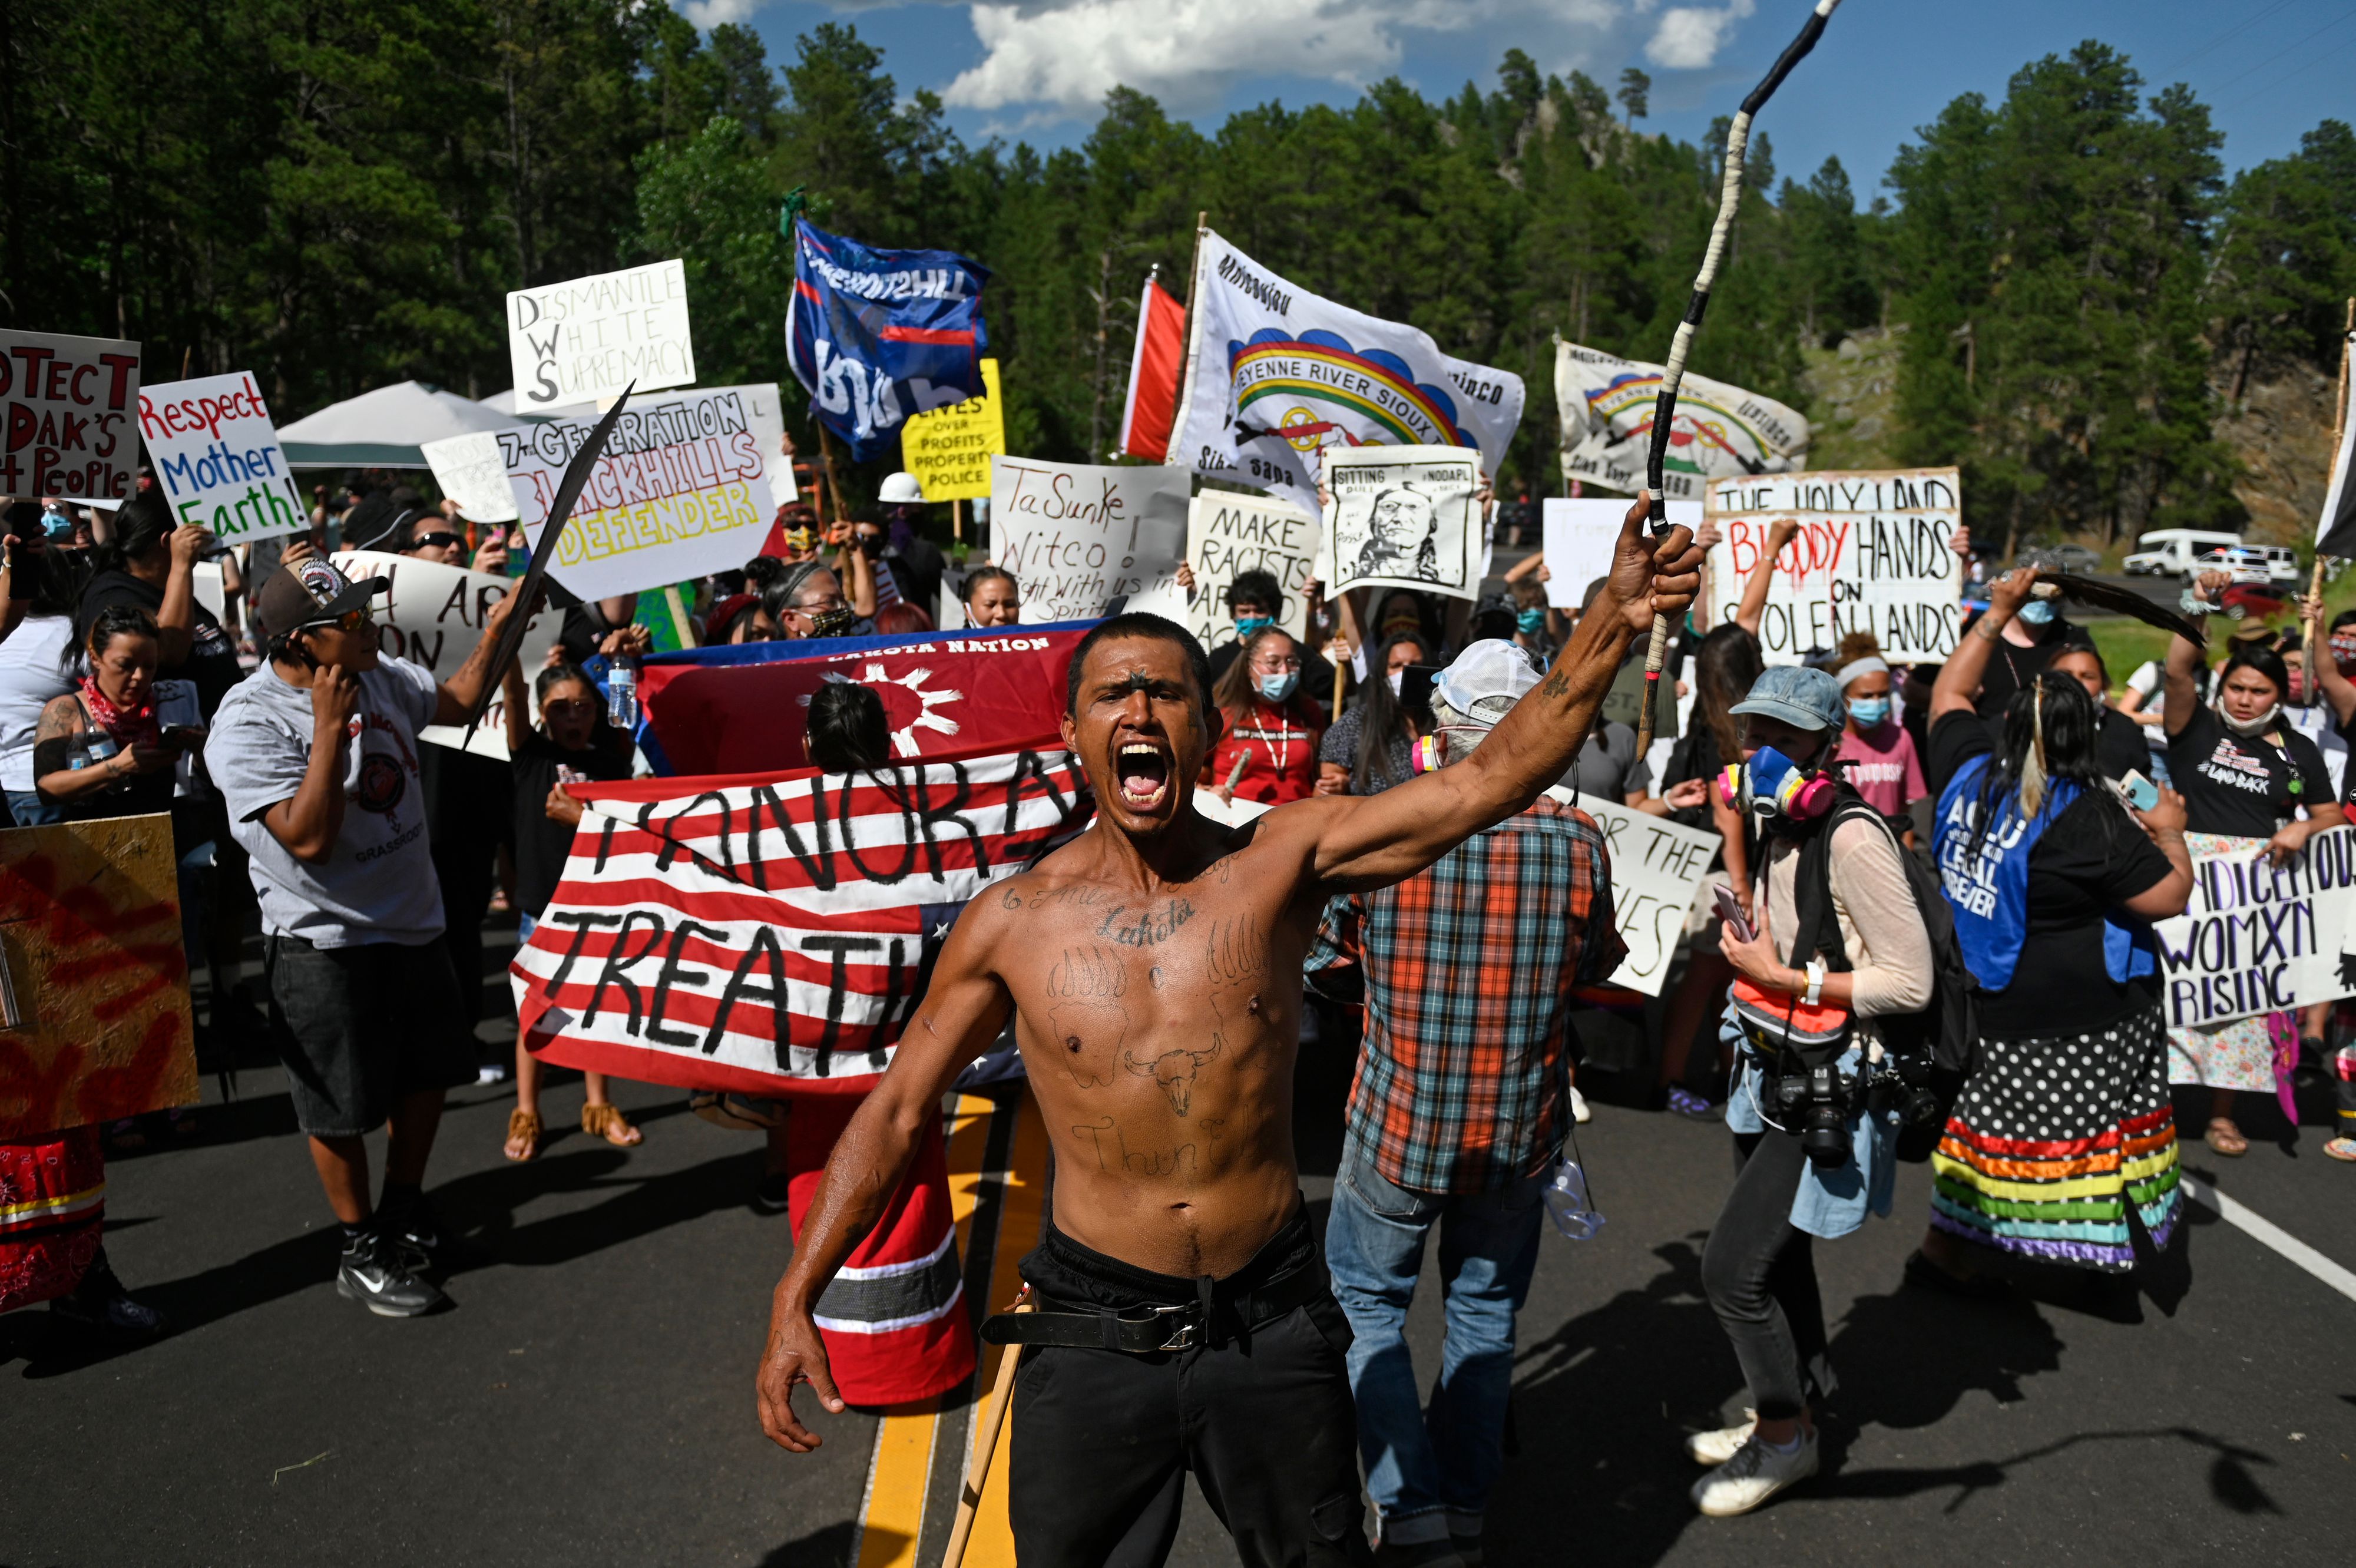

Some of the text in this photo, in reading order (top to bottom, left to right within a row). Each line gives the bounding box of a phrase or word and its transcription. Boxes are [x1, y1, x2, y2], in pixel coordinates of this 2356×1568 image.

[517, 266, 684, 330] DISMANTLE
[527, 307, 662, 360] WHITE
[528, 337, 688, 402] SUPREMACY
[138, 376, 266, 439] Respect
[933, 419, 969, 432] OVER
[1236, 361, 1432, 437] EYENNE RIVER SIOUX
[160, 441, 277, 496] Mother
[914, 449, 995, 468] PROPERTY
[921, 434, 985, 450] PROFITS
[929, 469, 984, 486] POLICE
[1336, 470, 1385, 485] SITTING
[1716, 478, 1955, 511] THE HOLY LAND
[178, 477, 305, 537] Earth!
[557, 481, 759, 567] DEFENDER
[1210, 507, 1306, 549] MAKE
[1199, 540, 1311, 591] RACISTS
[1856, 516, 1953, 581] HANDS
[436, 575, 537, 631] AR
[1014, 574, 1050, 607] ight
[1112, 577, 1141, 595] us
[1152, 570, 1174, 598] in
[1192, 582, 1295, 626] AFD
[1832, 579, 1862, 602] ON
[946, 637, 1050, 653] NATION
[1724, 601, 1855, 656] OLEN
[1591, 812, 1710, 882] OR THE
[1941, 839, 1998, 895] LEGAL
[2180, 826, 2356, 917] NDIGENOU
[1096, 899, 1196, 948] Lakota
[2153, 896, 2317, 974] WOMXN
[535, 910, 906, 1078] TREATI
[2171, 962, 2295, 1026] RISING
